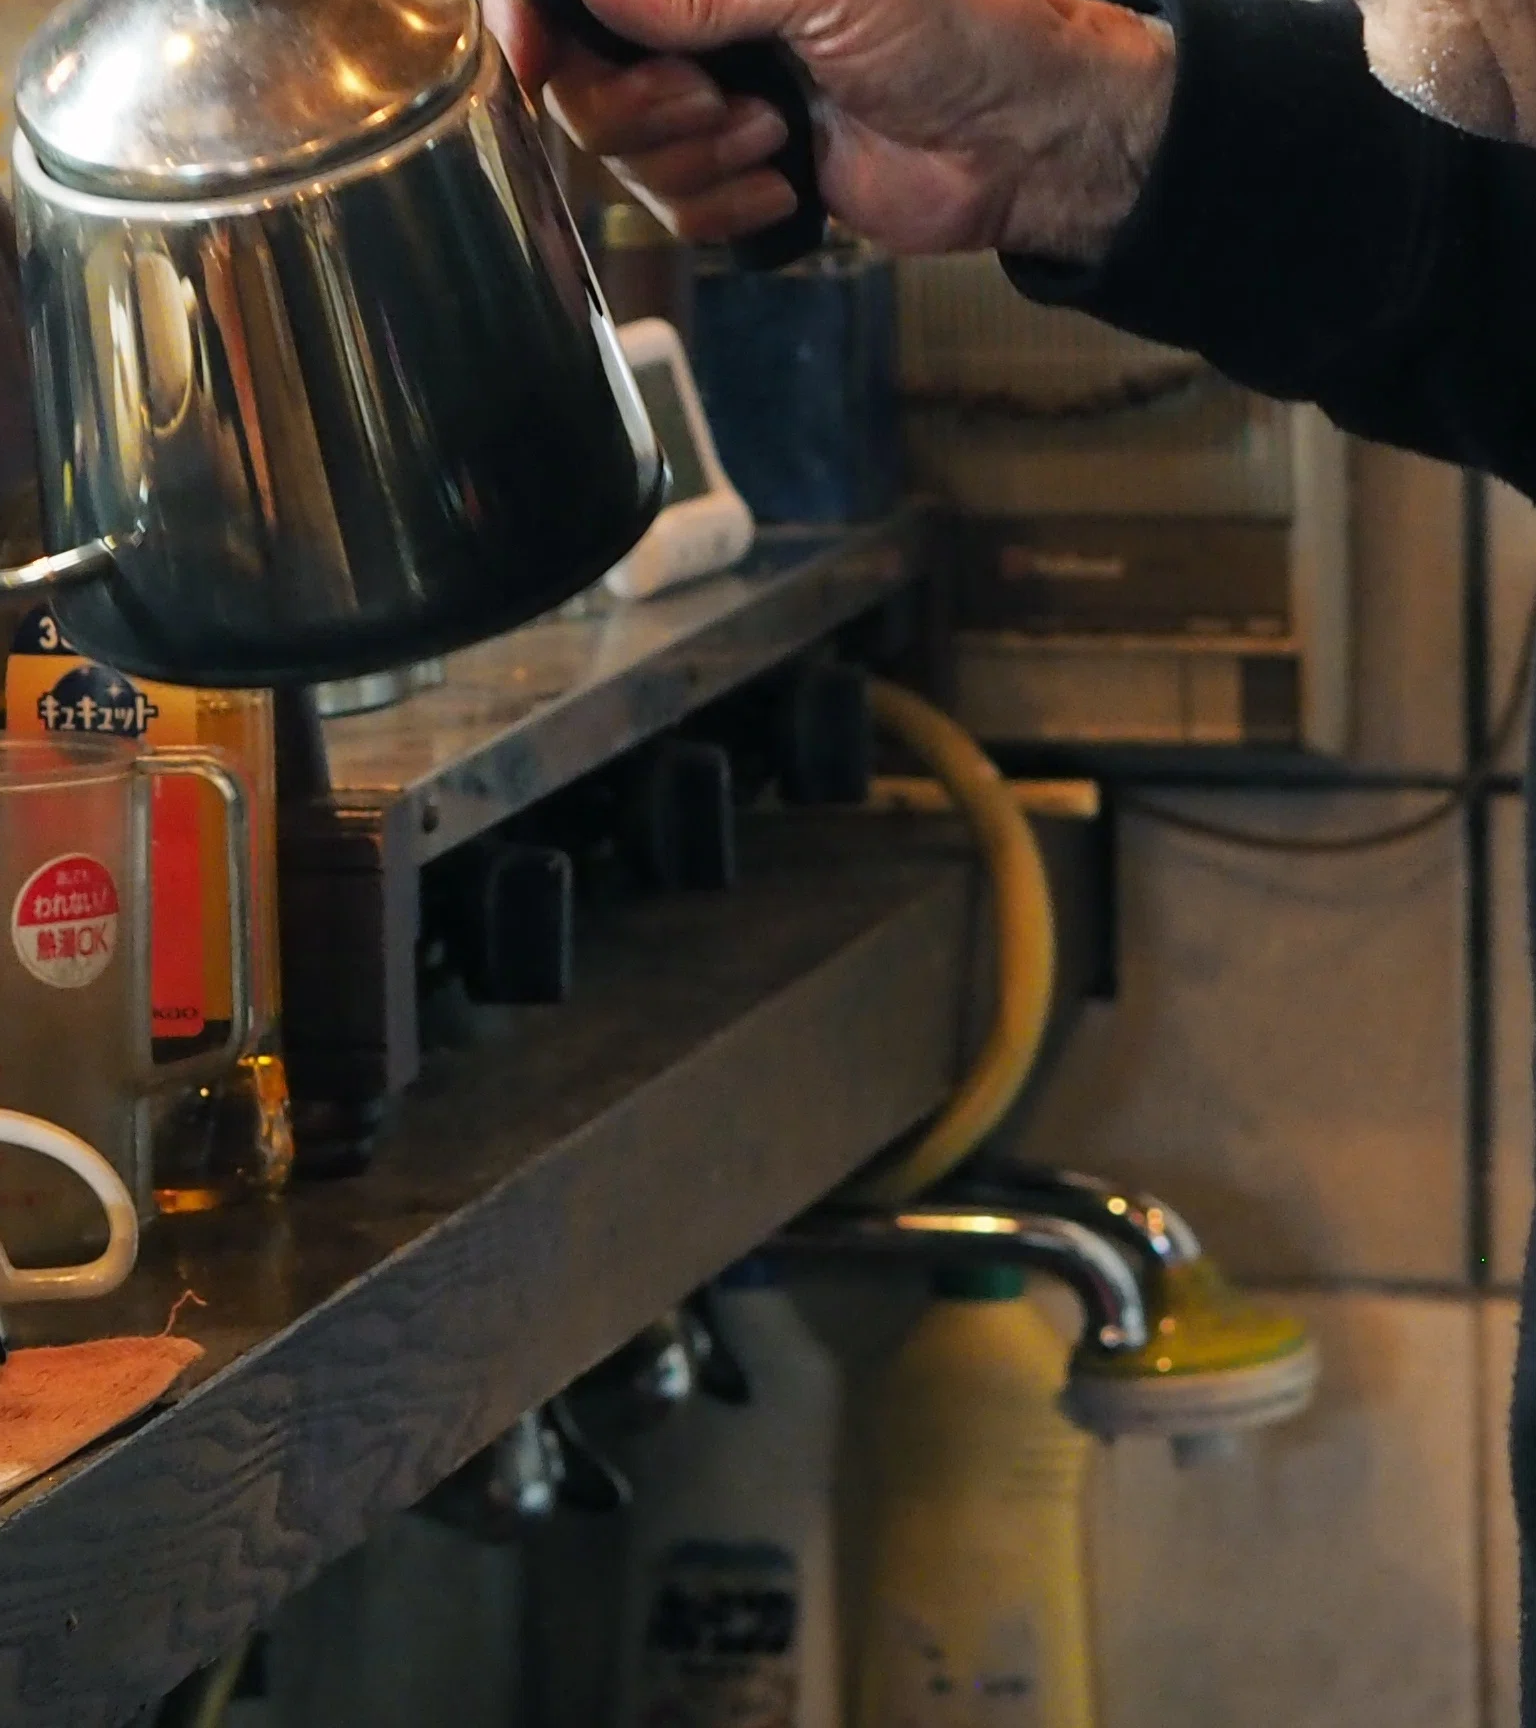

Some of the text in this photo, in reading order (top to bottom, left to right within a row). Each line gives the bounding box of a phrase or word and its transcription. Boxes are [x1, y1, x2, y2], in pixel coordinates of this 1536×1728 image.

[39, 693, 158, 732] キュキュット
